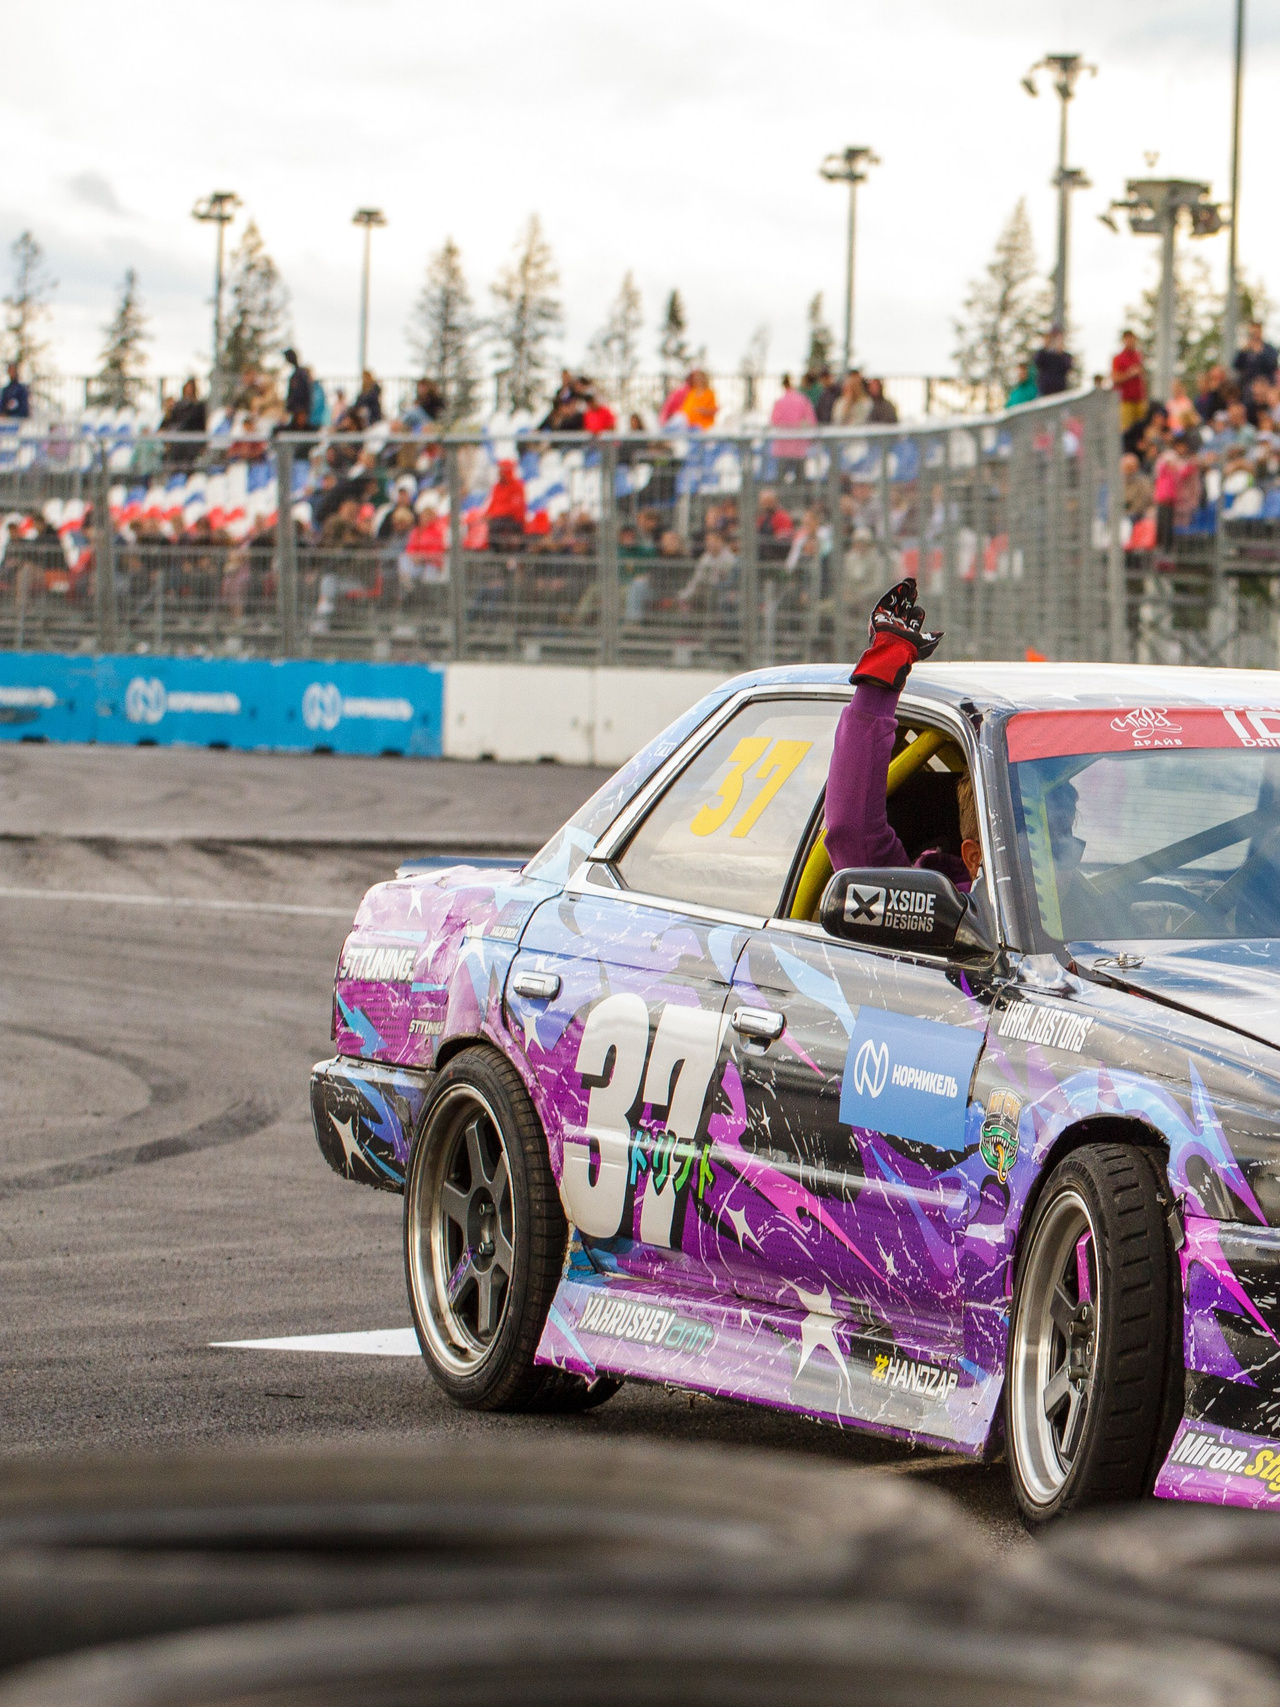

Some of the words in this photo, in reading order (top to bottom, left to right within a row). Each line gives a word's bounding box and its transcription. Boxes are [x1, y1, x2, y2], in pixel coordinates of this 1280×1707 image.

[1133, 737, 1183, 747] ДРАЙВ
[690, 737, 814, 838] 37
[887, 889, 937, 915] XSIDE
[884, 911, 935, 933] DESIGNS
[891, 1064, 959, 1099] НОРНИКЕЛЬ
[560, 992, 732, 1249] 37
[629, 1130, 714, 1199] ドリフト
